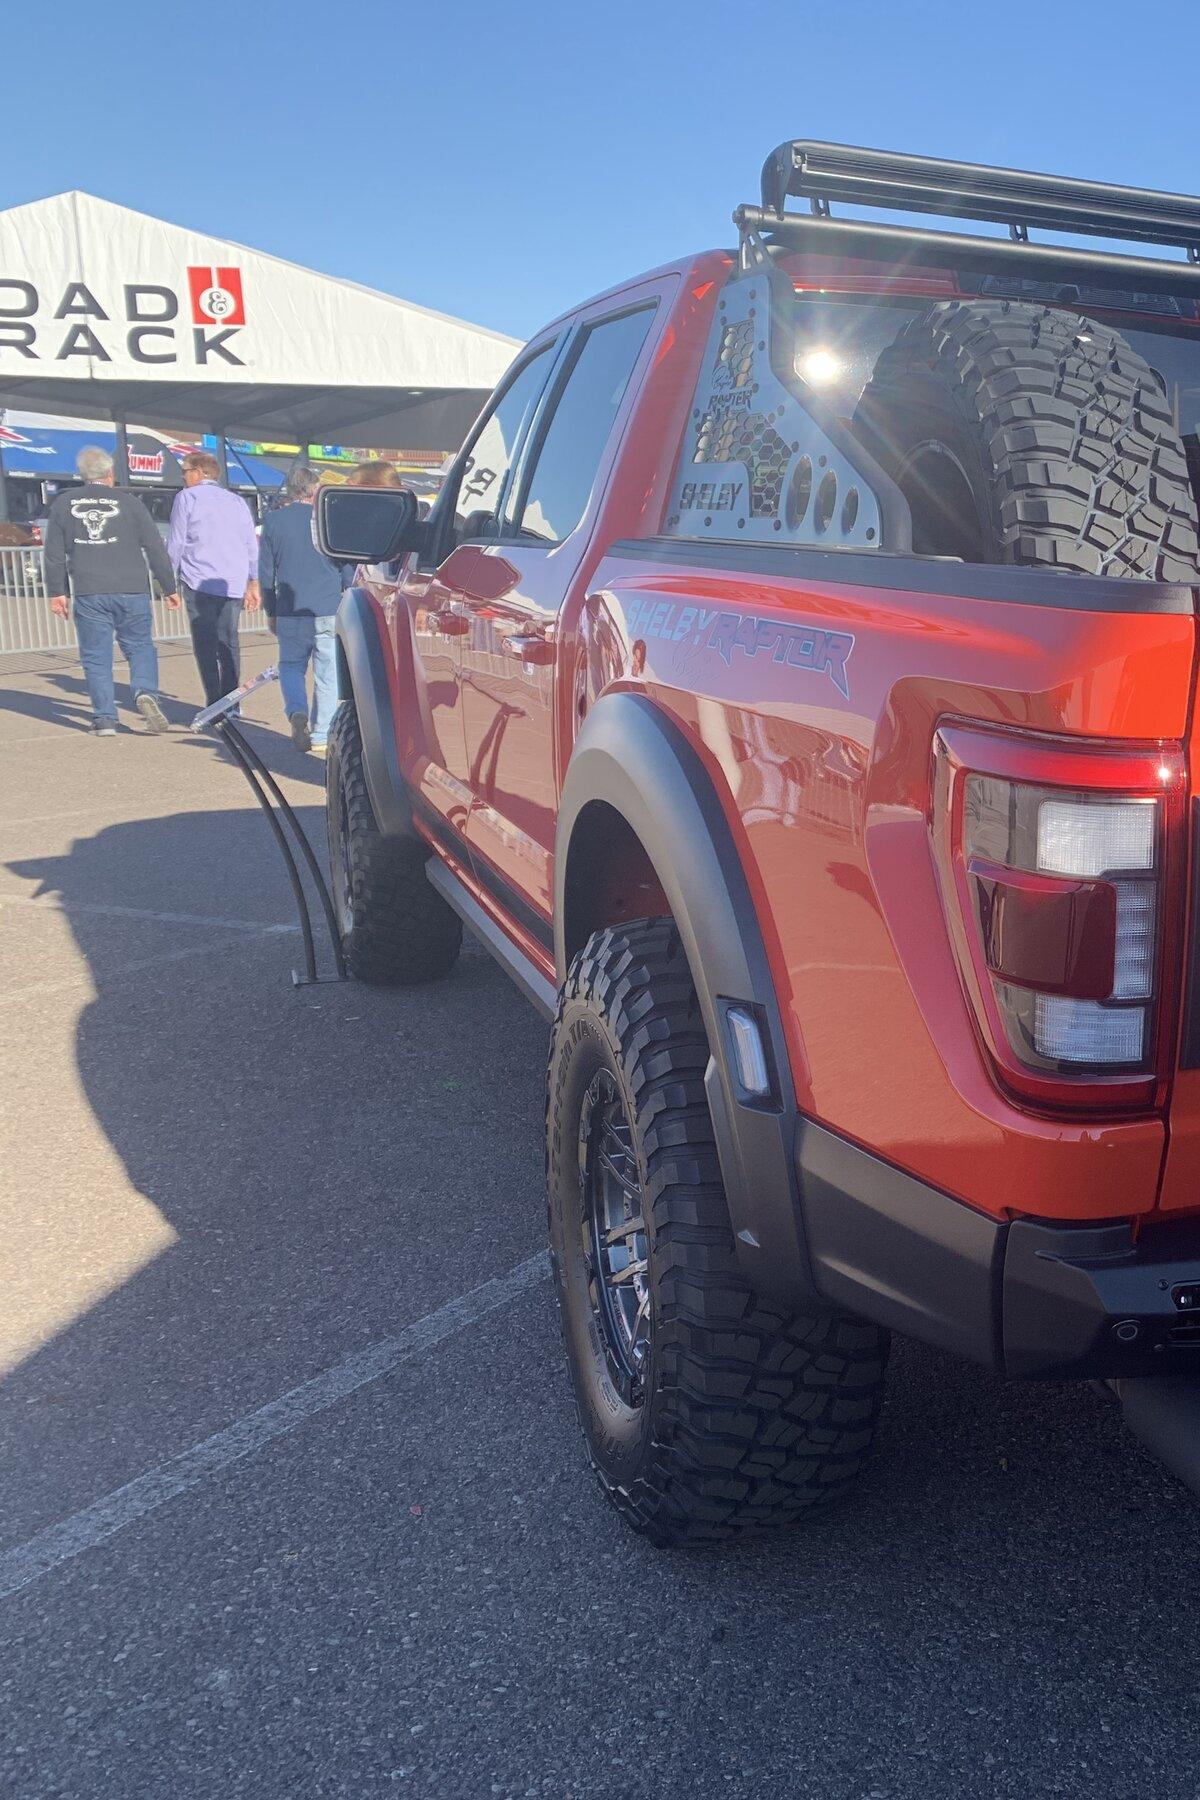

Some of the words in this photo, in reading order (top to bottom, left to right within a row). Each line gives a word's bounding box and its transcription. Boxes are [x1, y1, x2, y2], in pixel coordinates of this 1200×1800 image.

[679, 481, 743, 512] SHELBY
[627, 601, 716, 645] SHELBY
[707, 611, 856, 701] RAPTOR
